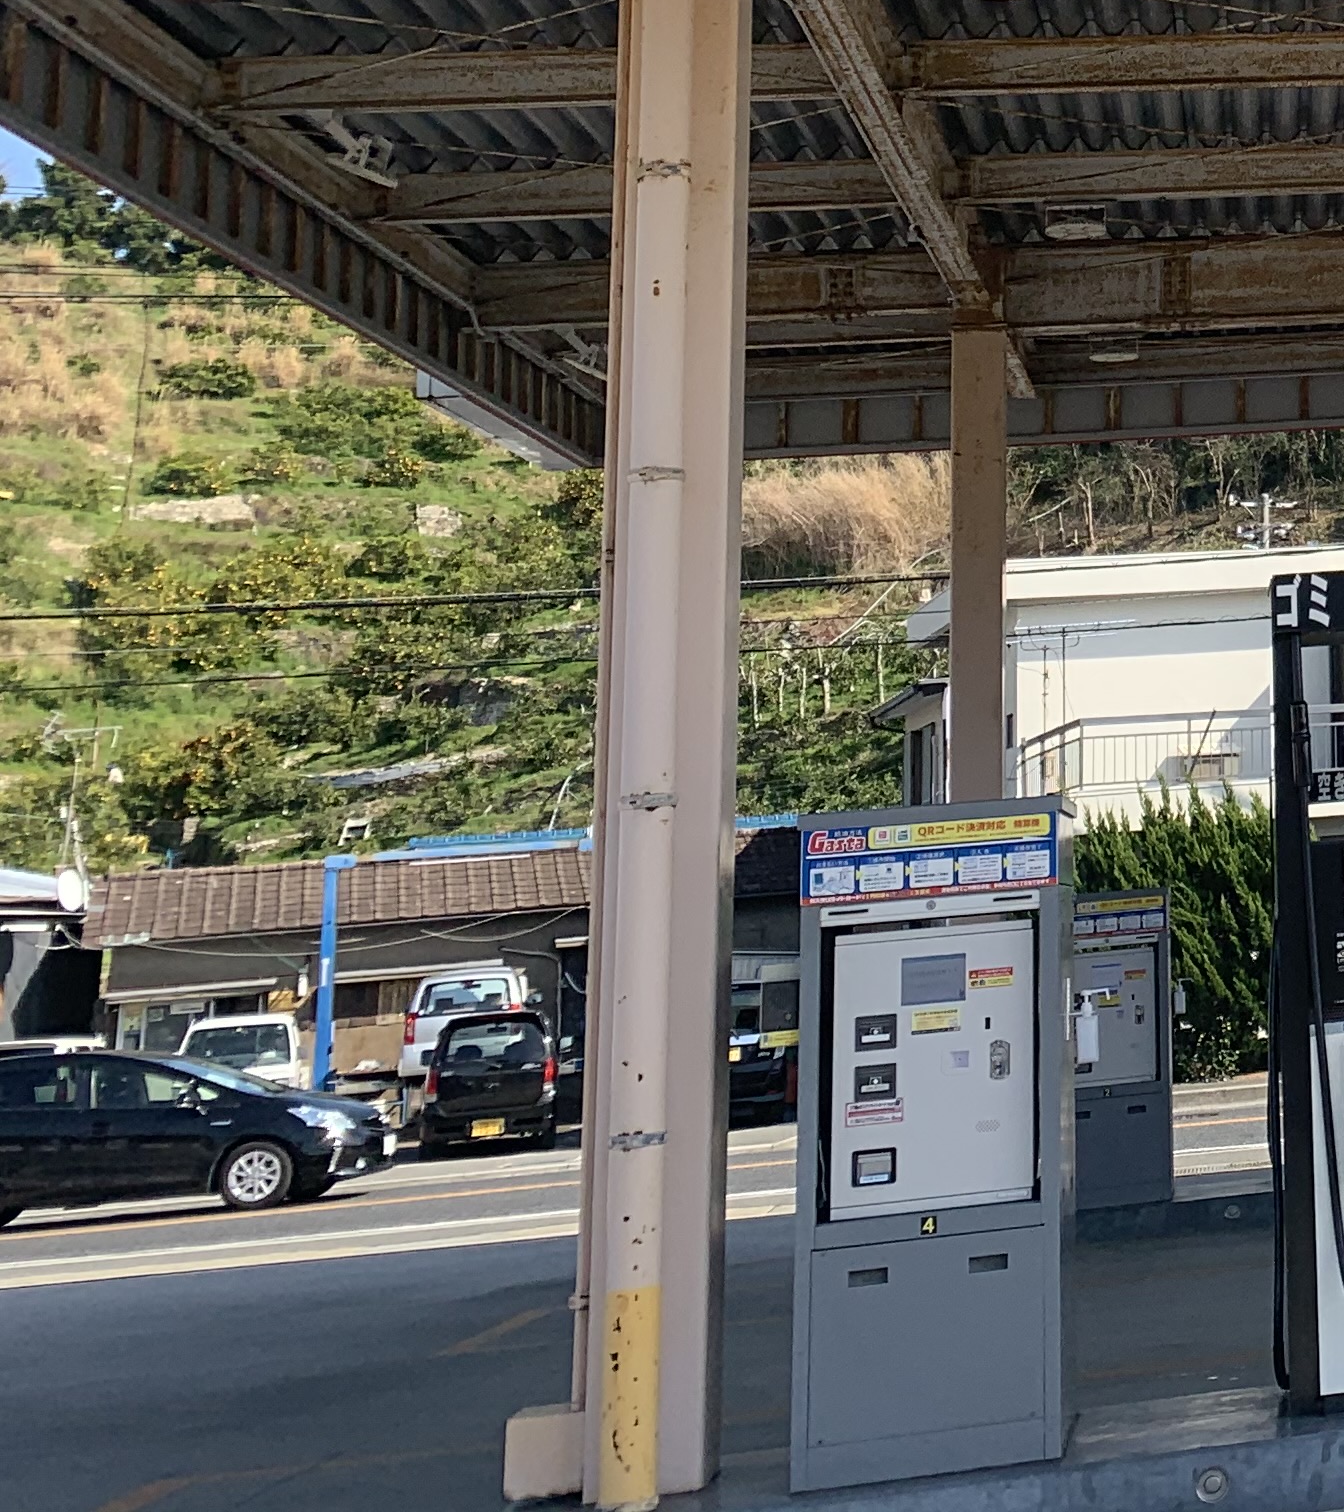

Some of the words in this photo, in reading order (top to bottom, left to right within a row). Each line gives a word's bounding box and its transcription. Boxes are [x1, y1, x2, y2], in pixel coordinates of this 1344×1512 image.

[808, 830, 866, 855] Gasta
[1105, 1088, 1111, 1097] 2
[922, 1217, 935, 1235] 4
